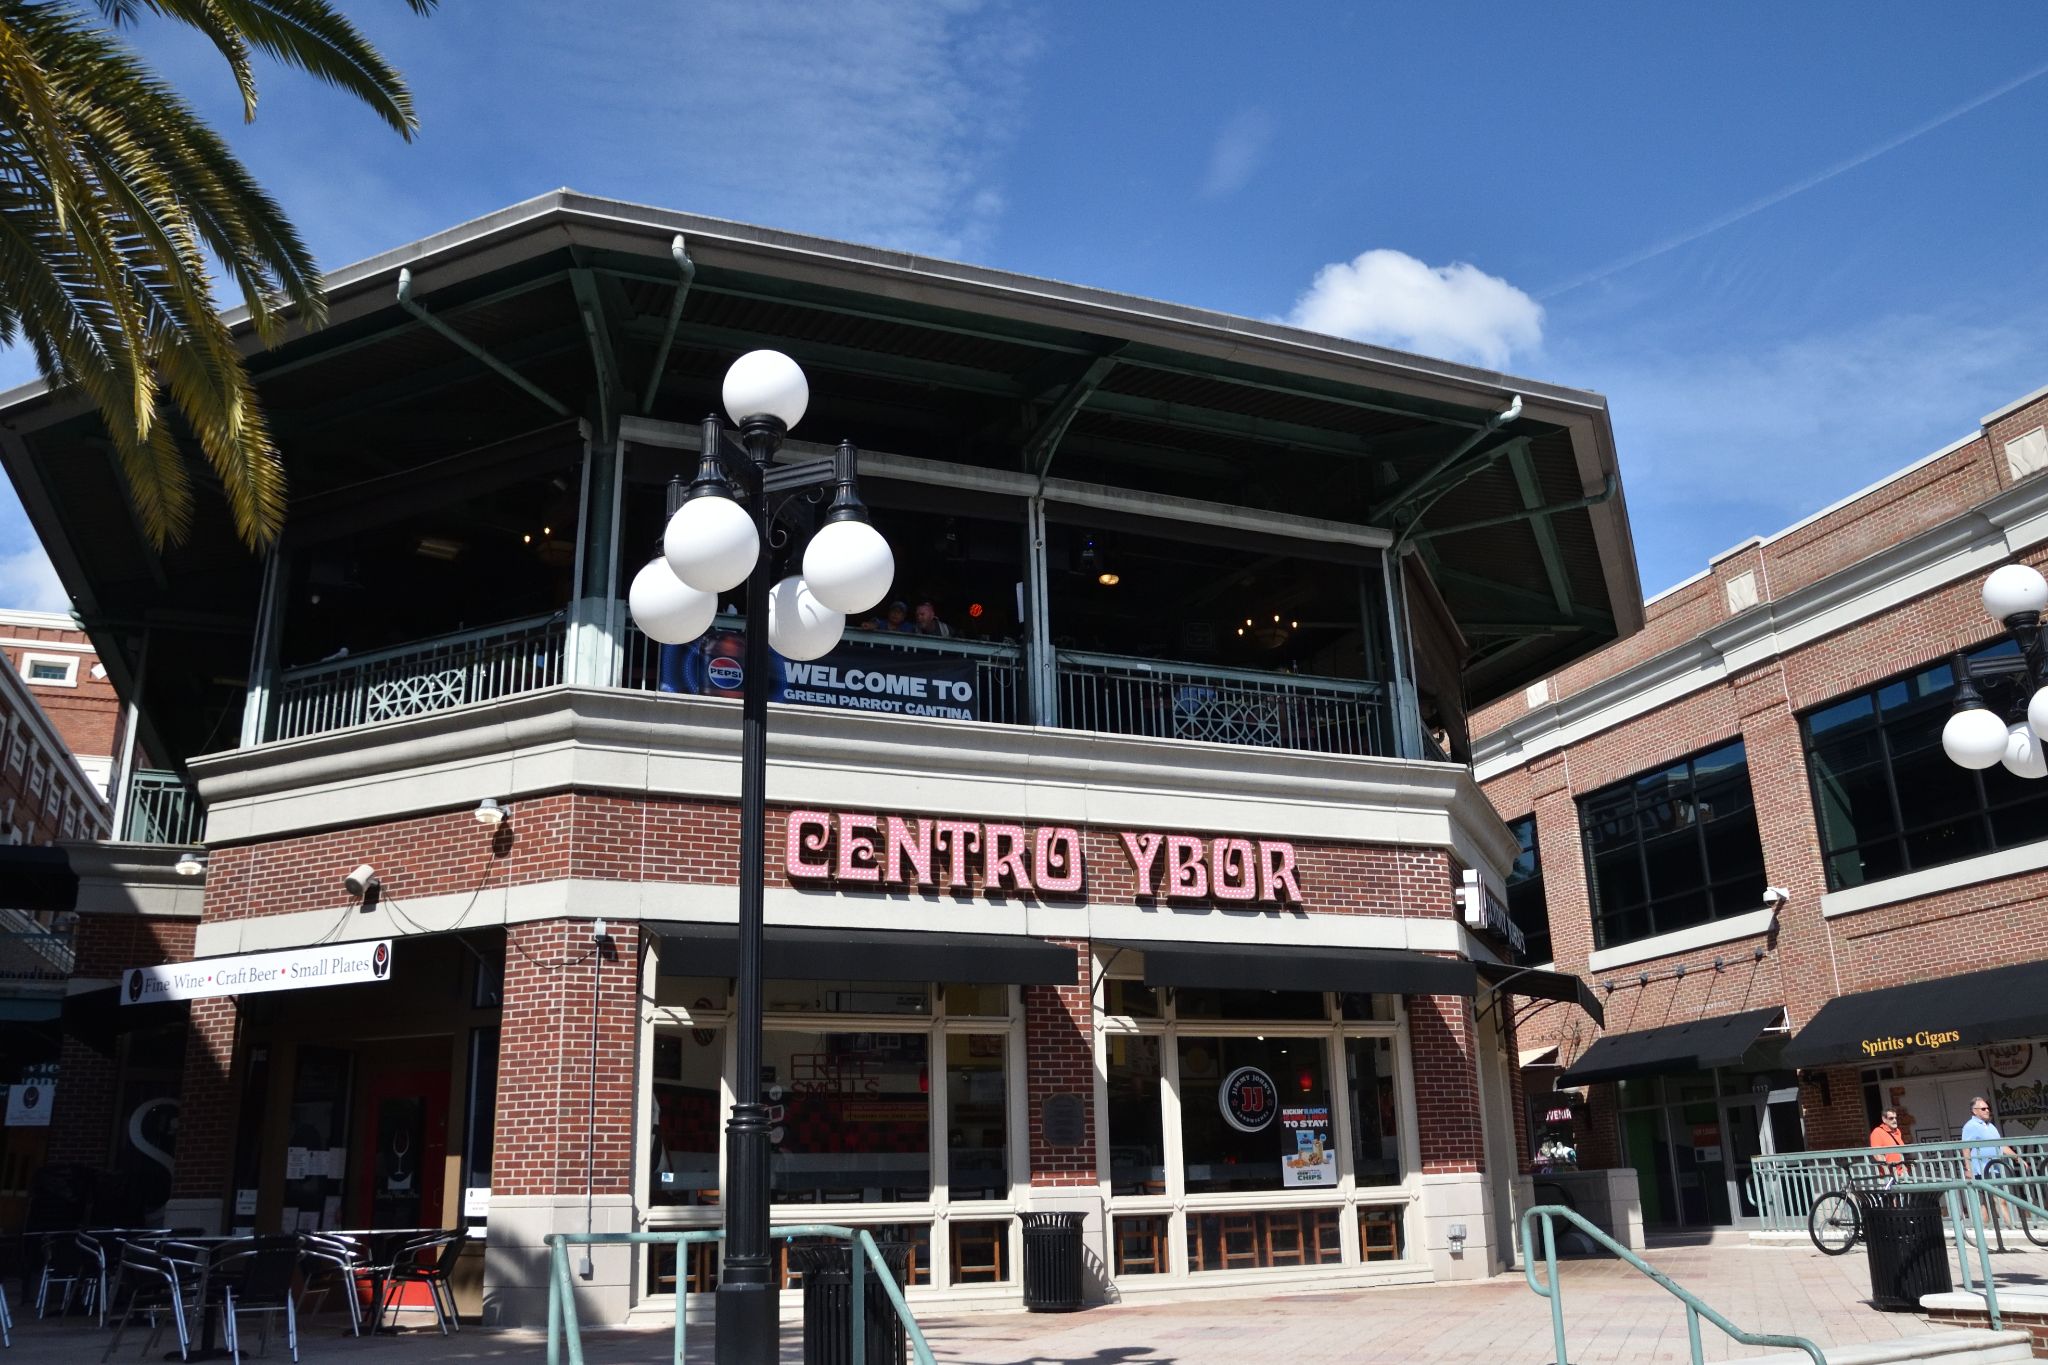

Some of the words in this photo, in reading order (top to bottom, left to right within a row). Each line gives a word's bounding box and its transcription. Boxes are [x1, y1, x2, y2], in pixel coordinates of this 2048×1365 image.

[709, 667, 742, 680] PEPSI
[783, 660, 928, 699] WELCOME
[931, 678, 973, 702] TO
[782, 688, 837, 706] GREEN
[838, 694, 903, 714] PARROT
[904, 702, 973, 721] CANTINA
[785, 809, 1083, 893] CENTRO
[1118, 831, 1304, 902] YBOR
[144, 977, 170, 993] Fine
[173, 974, 205, 991] Wine
[215, 967, 247, 987] Craft
[249, 966, 278, 983] Beer
[290, 959, 328, 979] Small
[331, 956, 370, 975] Plates
[1861, 1036, 1904, 1057] Spirits
[1915, 1029, 1960, 1049] Cigars
[1231, 1074, 1250, 1095] JIMMY
[1241, 1086, 1263, 1111] JJ
[1283, 1120, 1298, 1128] TO
[1299, 1119, 1328, 1128] STAY!
